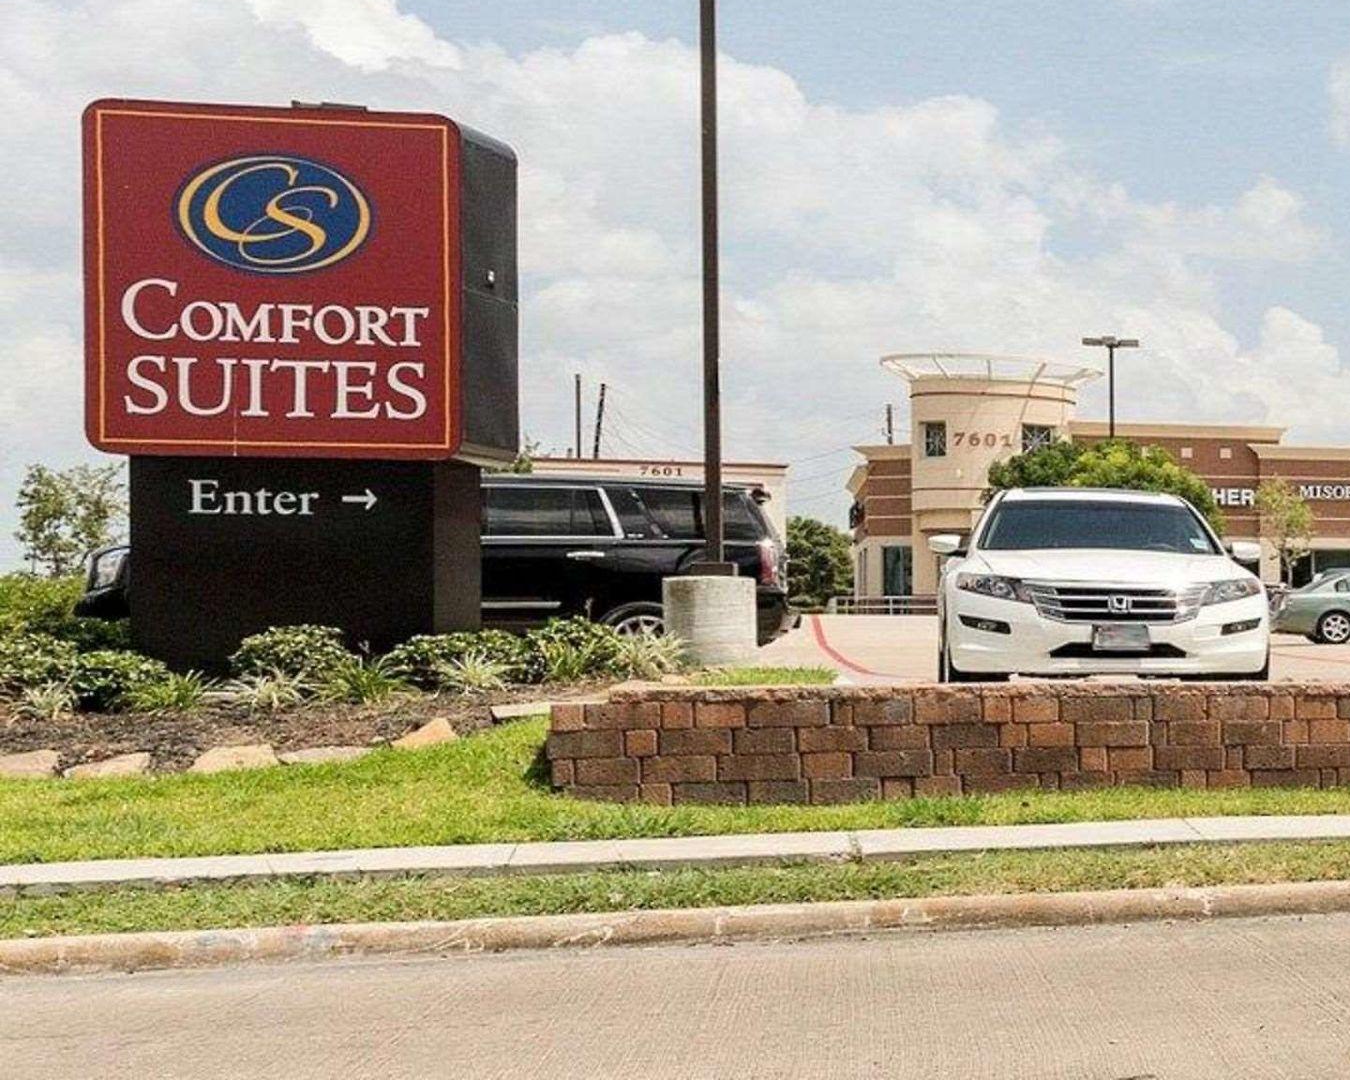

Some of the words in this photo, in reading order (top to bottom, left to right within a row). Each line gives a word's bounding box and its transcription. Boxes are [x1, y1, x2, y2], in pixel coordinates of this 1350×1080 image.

[121, 278, 429, 347] COMFORT
[124, 355, 427, 420] SUITES
[953, 431, 1013, 447] 7601
[640, 464, 682, 477] 7601
[187, 479, 320, 515] Enter
